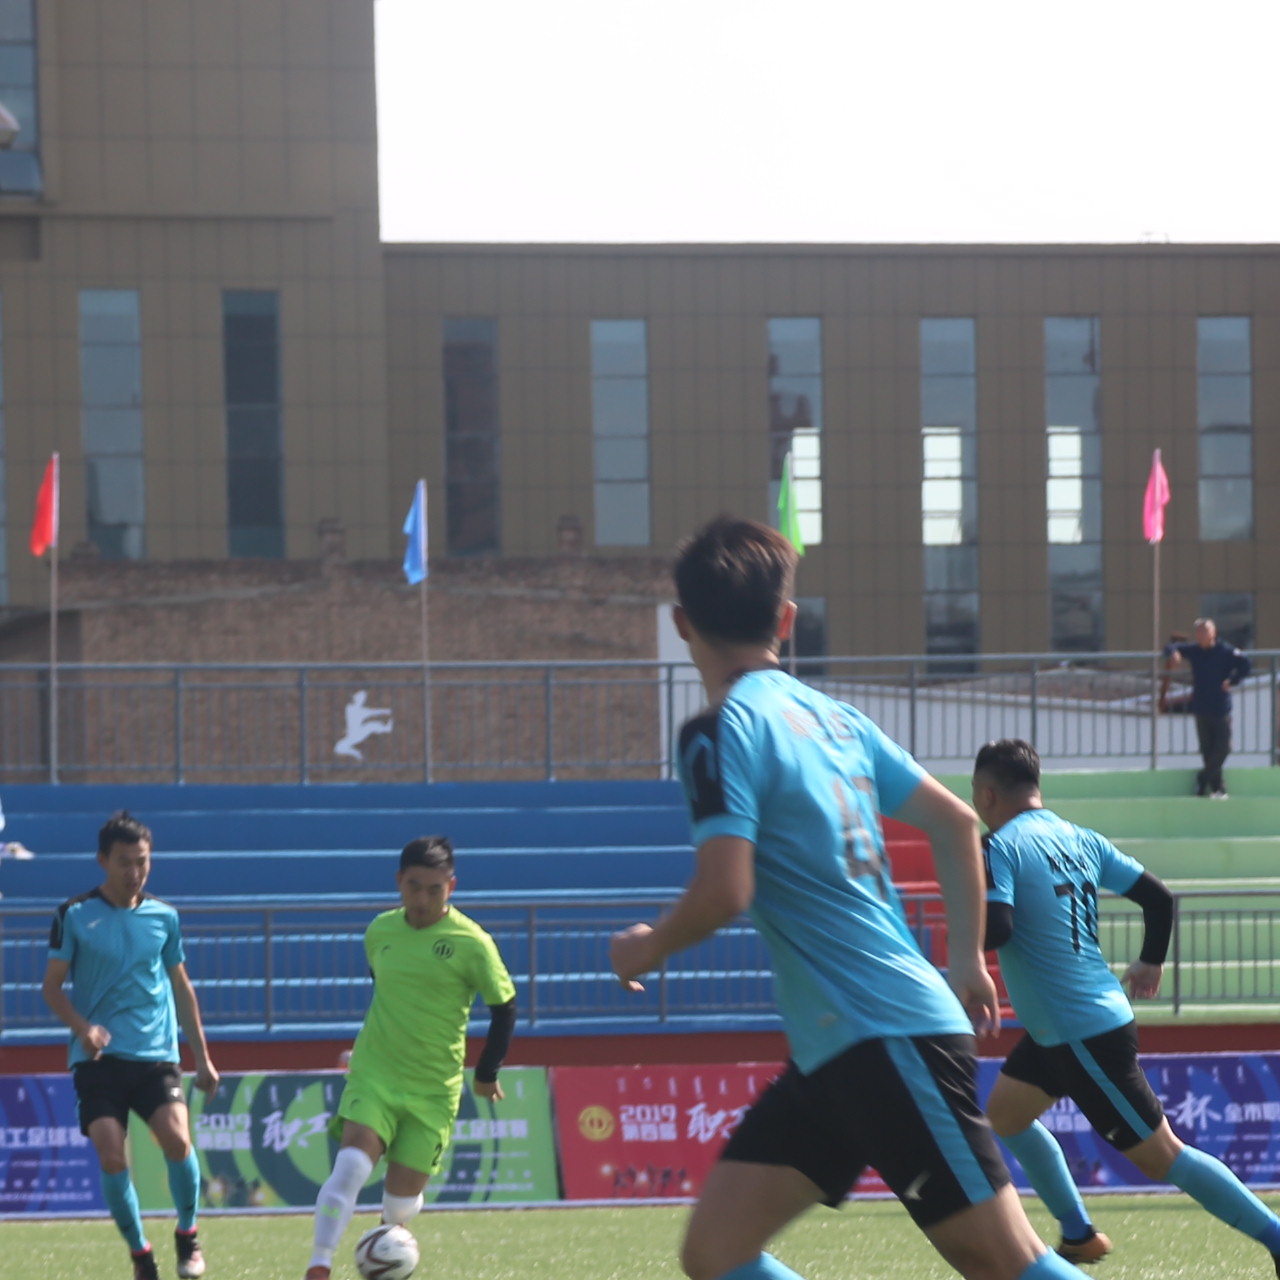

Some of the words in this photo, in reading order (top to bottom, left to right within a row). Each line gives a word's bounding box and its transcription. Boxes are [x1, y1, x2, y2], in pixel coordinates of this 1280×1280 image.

[195, 1113, 252, 1132] 2019
[620, 1104, 677, 1122] 2019
[261, 1110, 331, 1153] 职工
